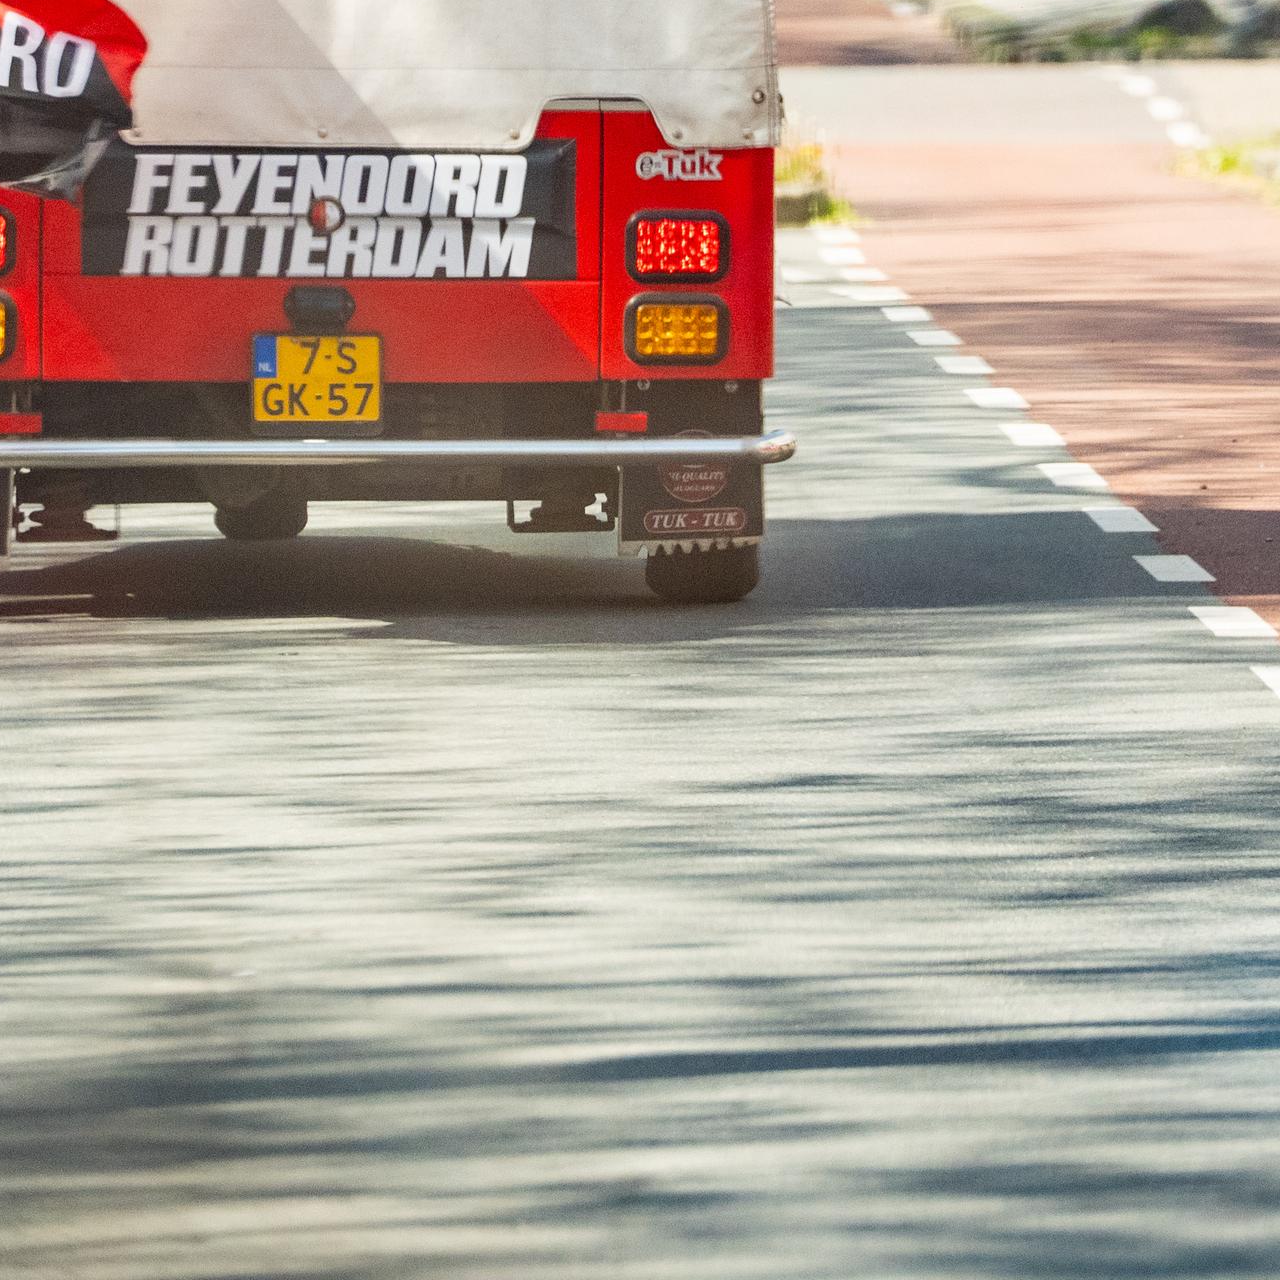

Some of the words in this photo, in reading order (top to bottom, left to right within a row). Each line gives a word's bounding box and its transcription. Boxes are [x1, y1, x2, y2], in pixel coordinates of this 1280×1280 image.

[127, 153, 528, 218] FEYENOORD
[121, 216, 536, 278] ROTTERDAM
[258, 363, 272, 373] NL
[301, 340, 357, 375] 7-S
[262, 383, 374, 416] GK-57
[652, 514, 688, 528] TUK
[703, 512, 738, 526] TUK
